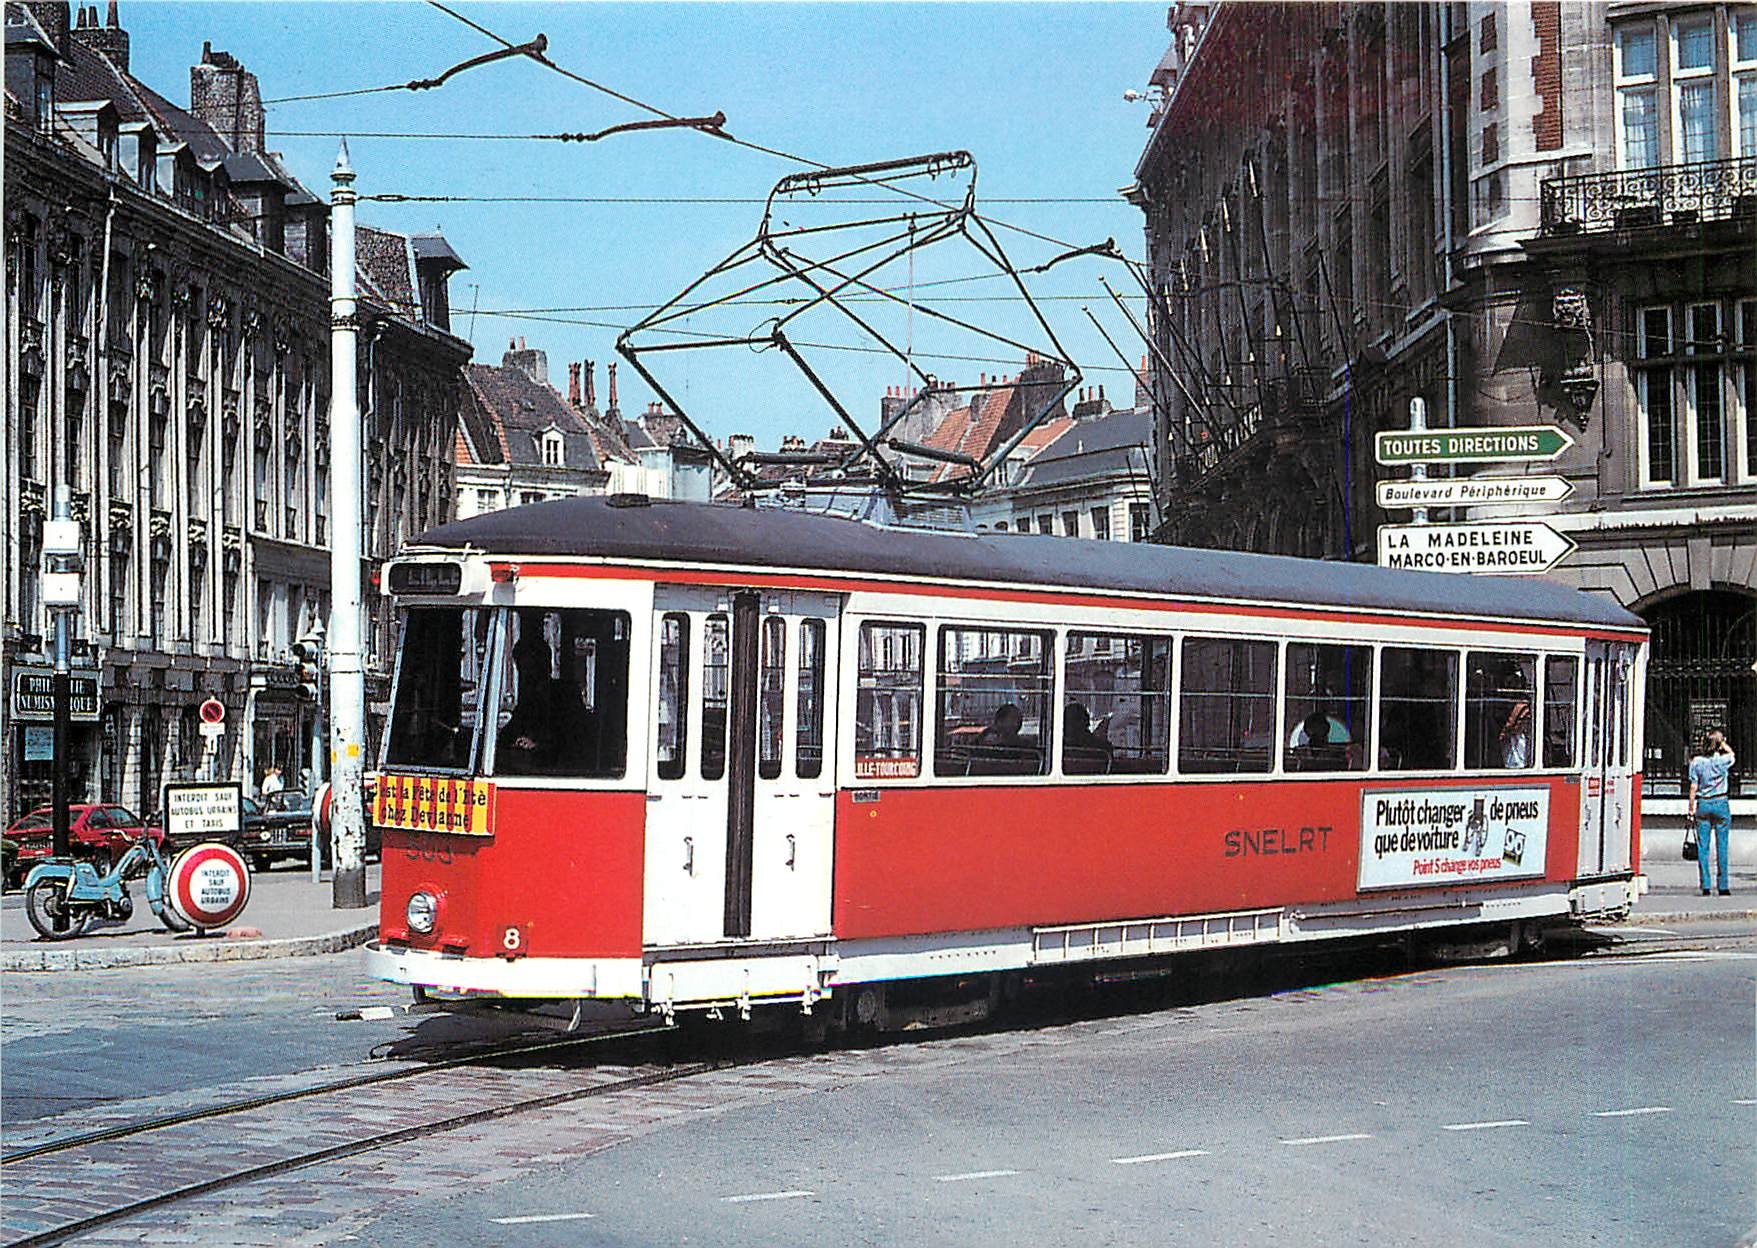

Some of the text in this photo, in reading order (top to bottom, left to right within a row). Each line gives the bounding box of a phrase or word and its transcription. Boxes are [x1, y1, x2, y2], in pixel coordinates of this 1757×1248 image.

[1384, 435, 1539, 455] TOUTES DIRECTIONS
[1386, 486, 1452, 500] Boulevard
[1388, 530, 1533, 549] LA MADELEINE
[174, 792, 232, 803] INTERDIT SAUF
[171, 804, 237, 816] AUTOBUS URBAINS
[1376, 795, 1539, 828] Plutôt changer de pneus
[185, 818, 224, 829] ET TAXIS
[1224, 825, 1333, 858] SNELRT
[1375, 825, 1459, 859] que de voiture
[1413, 858, 1434, 875] Point
[1434, 857, 1440, 874] S
[1440, 857, 1467, 875] change
[1467, 859, 1479, 872] vos
[1479, 857, 1502, 875] pneus
[503, 928, 520, 950] 8
